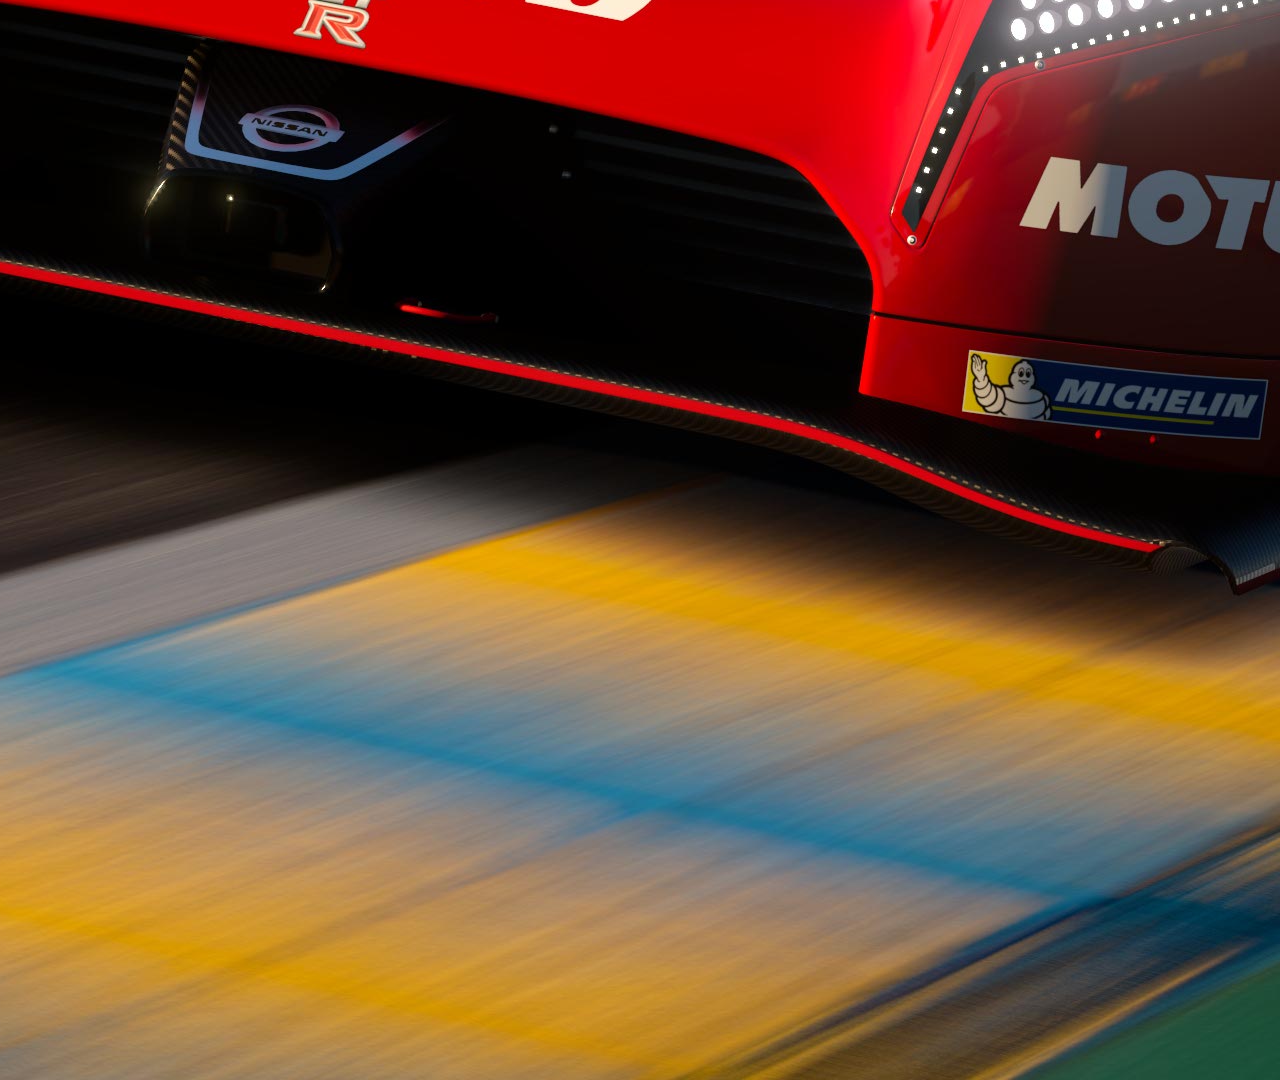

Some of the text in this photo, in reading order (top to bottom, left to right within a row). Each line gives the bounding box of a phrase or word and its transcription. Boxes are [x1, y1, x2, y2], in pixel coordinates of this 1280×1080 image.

[293, 2, 370, 50] R
[251, 117, 329, 137] NISSAN
[1056, 378, 1259, 419] MICHELIN
